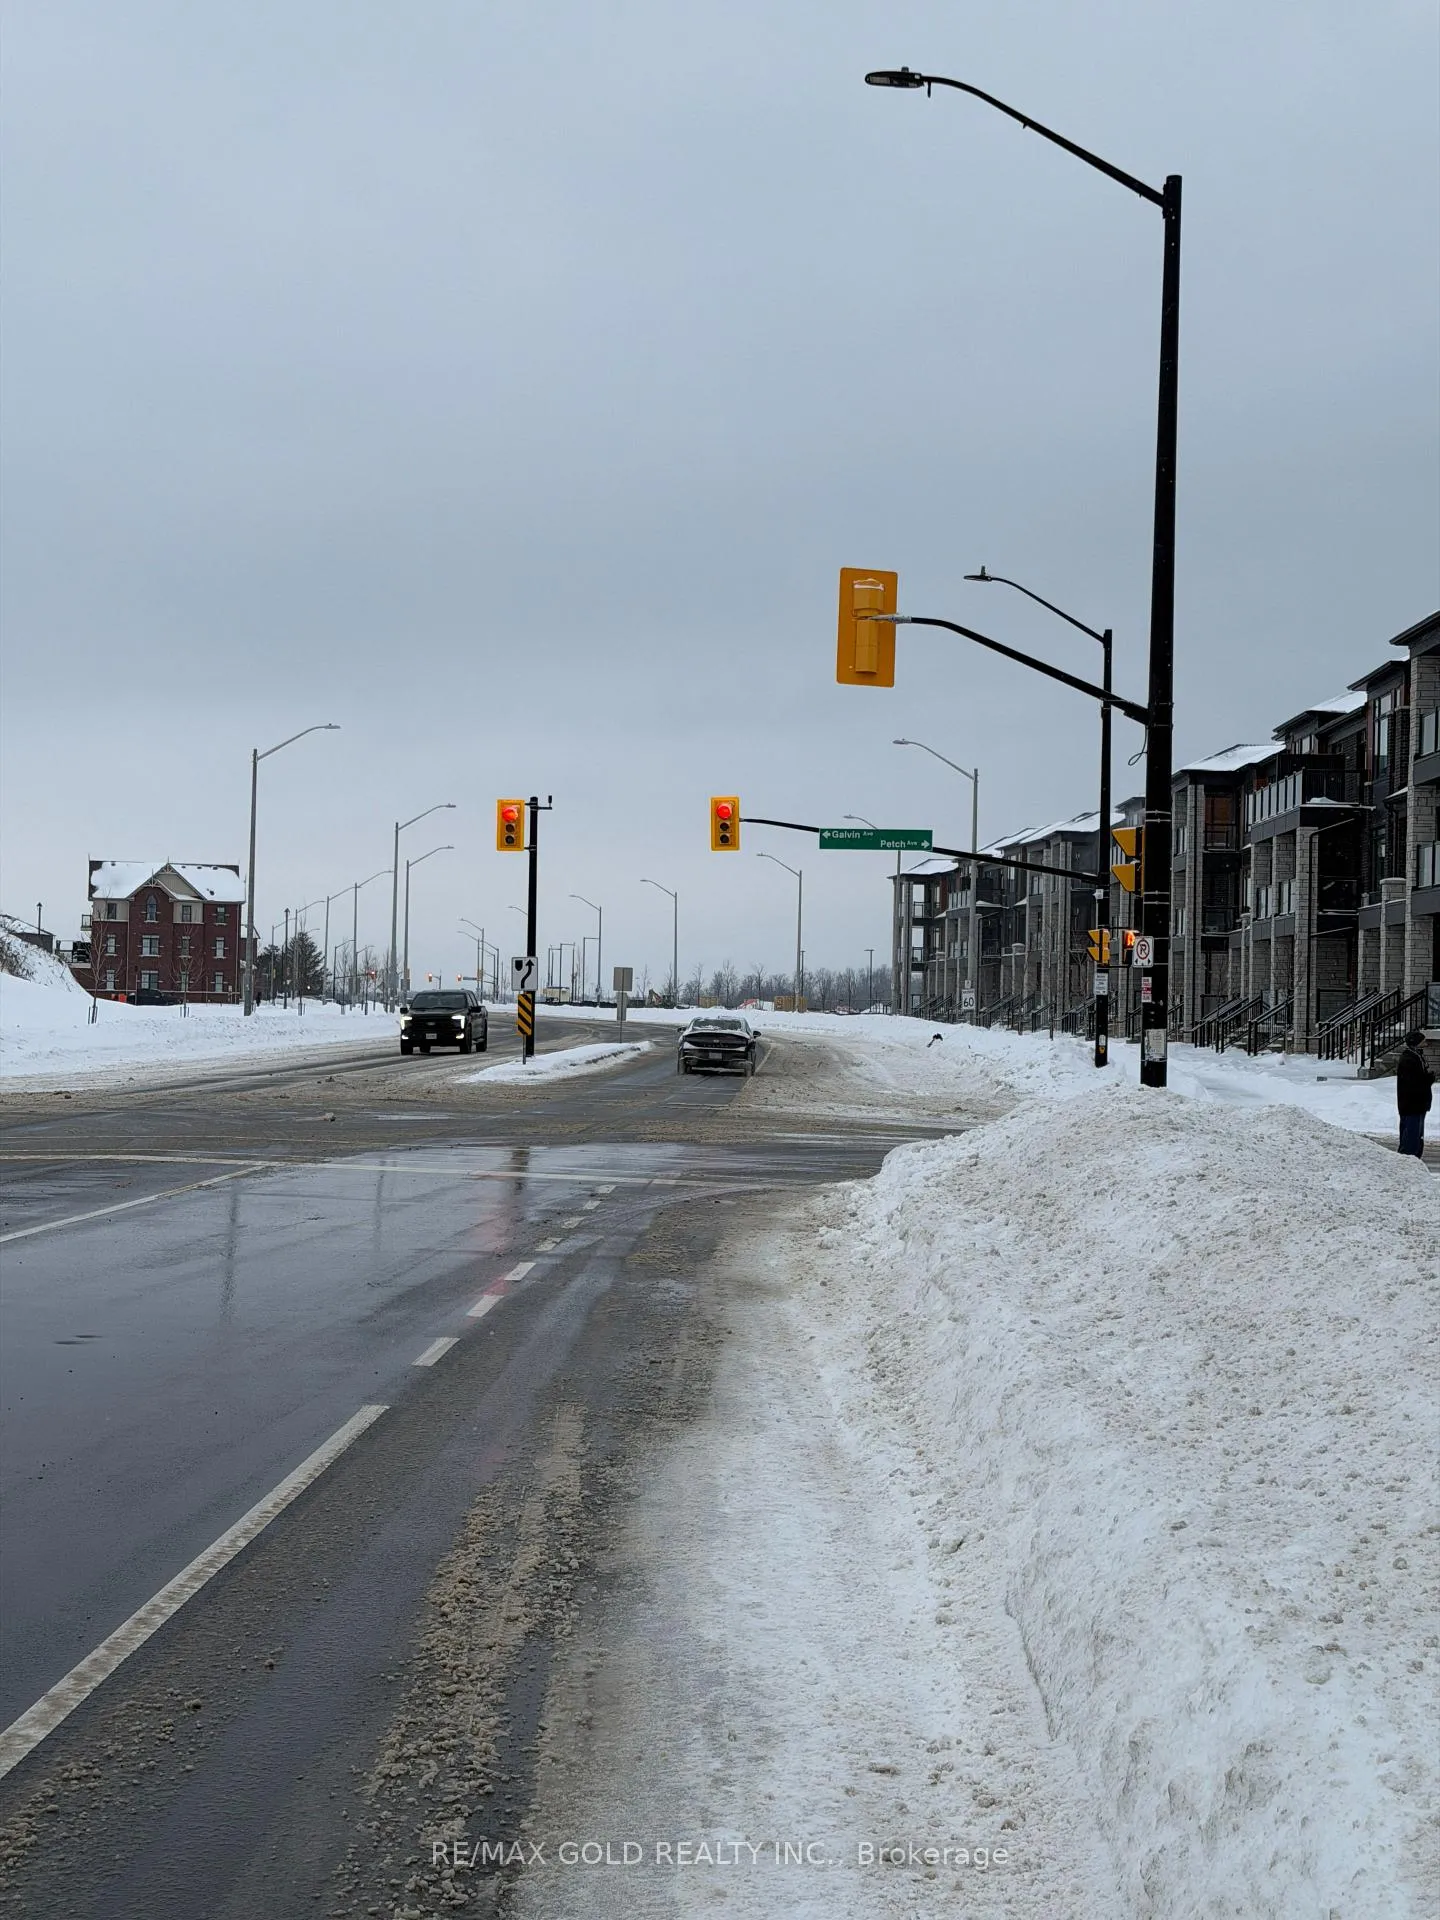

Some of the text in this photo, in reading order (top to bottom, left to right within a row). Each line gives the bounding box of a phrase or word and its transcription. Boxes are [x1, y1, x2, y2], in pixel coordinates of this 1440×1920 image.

[832, 830, 860, 838] Galvin
[880, 840, 906, 848] Petch
[964, 997, 974, 1007] 60
